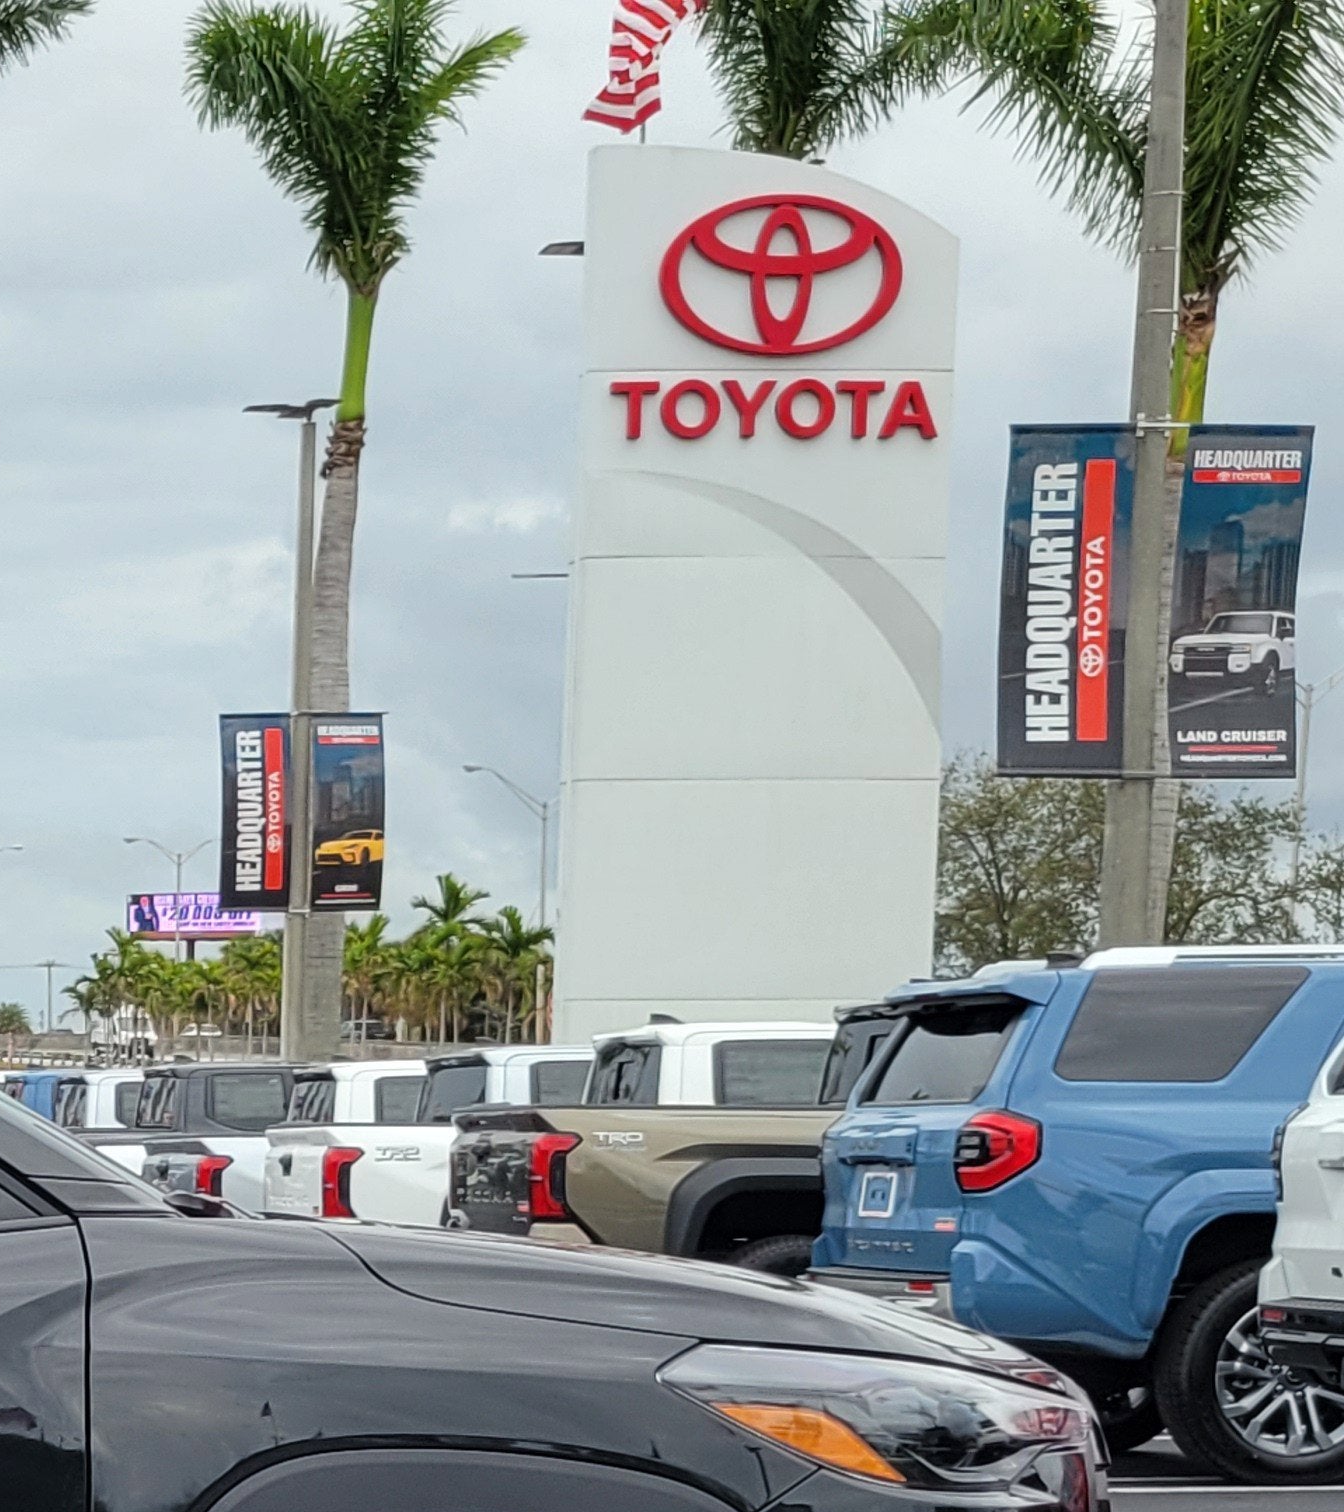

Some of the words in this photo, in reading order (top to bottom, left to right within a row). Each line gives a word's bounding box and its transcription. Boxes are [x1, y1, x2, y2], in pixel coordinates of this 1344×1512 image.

[609, 378, 938, 440] TOYOTA
[1194, 450, 1302, 470] HEADQUARTER
[1232, 471, 1272, 480] TOYOTA
[1025, 462, 1078, 742] HEADQUARTER
[1083, 536, 1106, 641] TOYOTA
[1176, 731, 1218, 742] LAND
[1221, 730, 1288, 741] CRUISER
[235, 730, 266, 891] HEADQUARTER
[268, 771, 283, 832] TOYOTA
[592, 1131, 644, 1145] TRD
